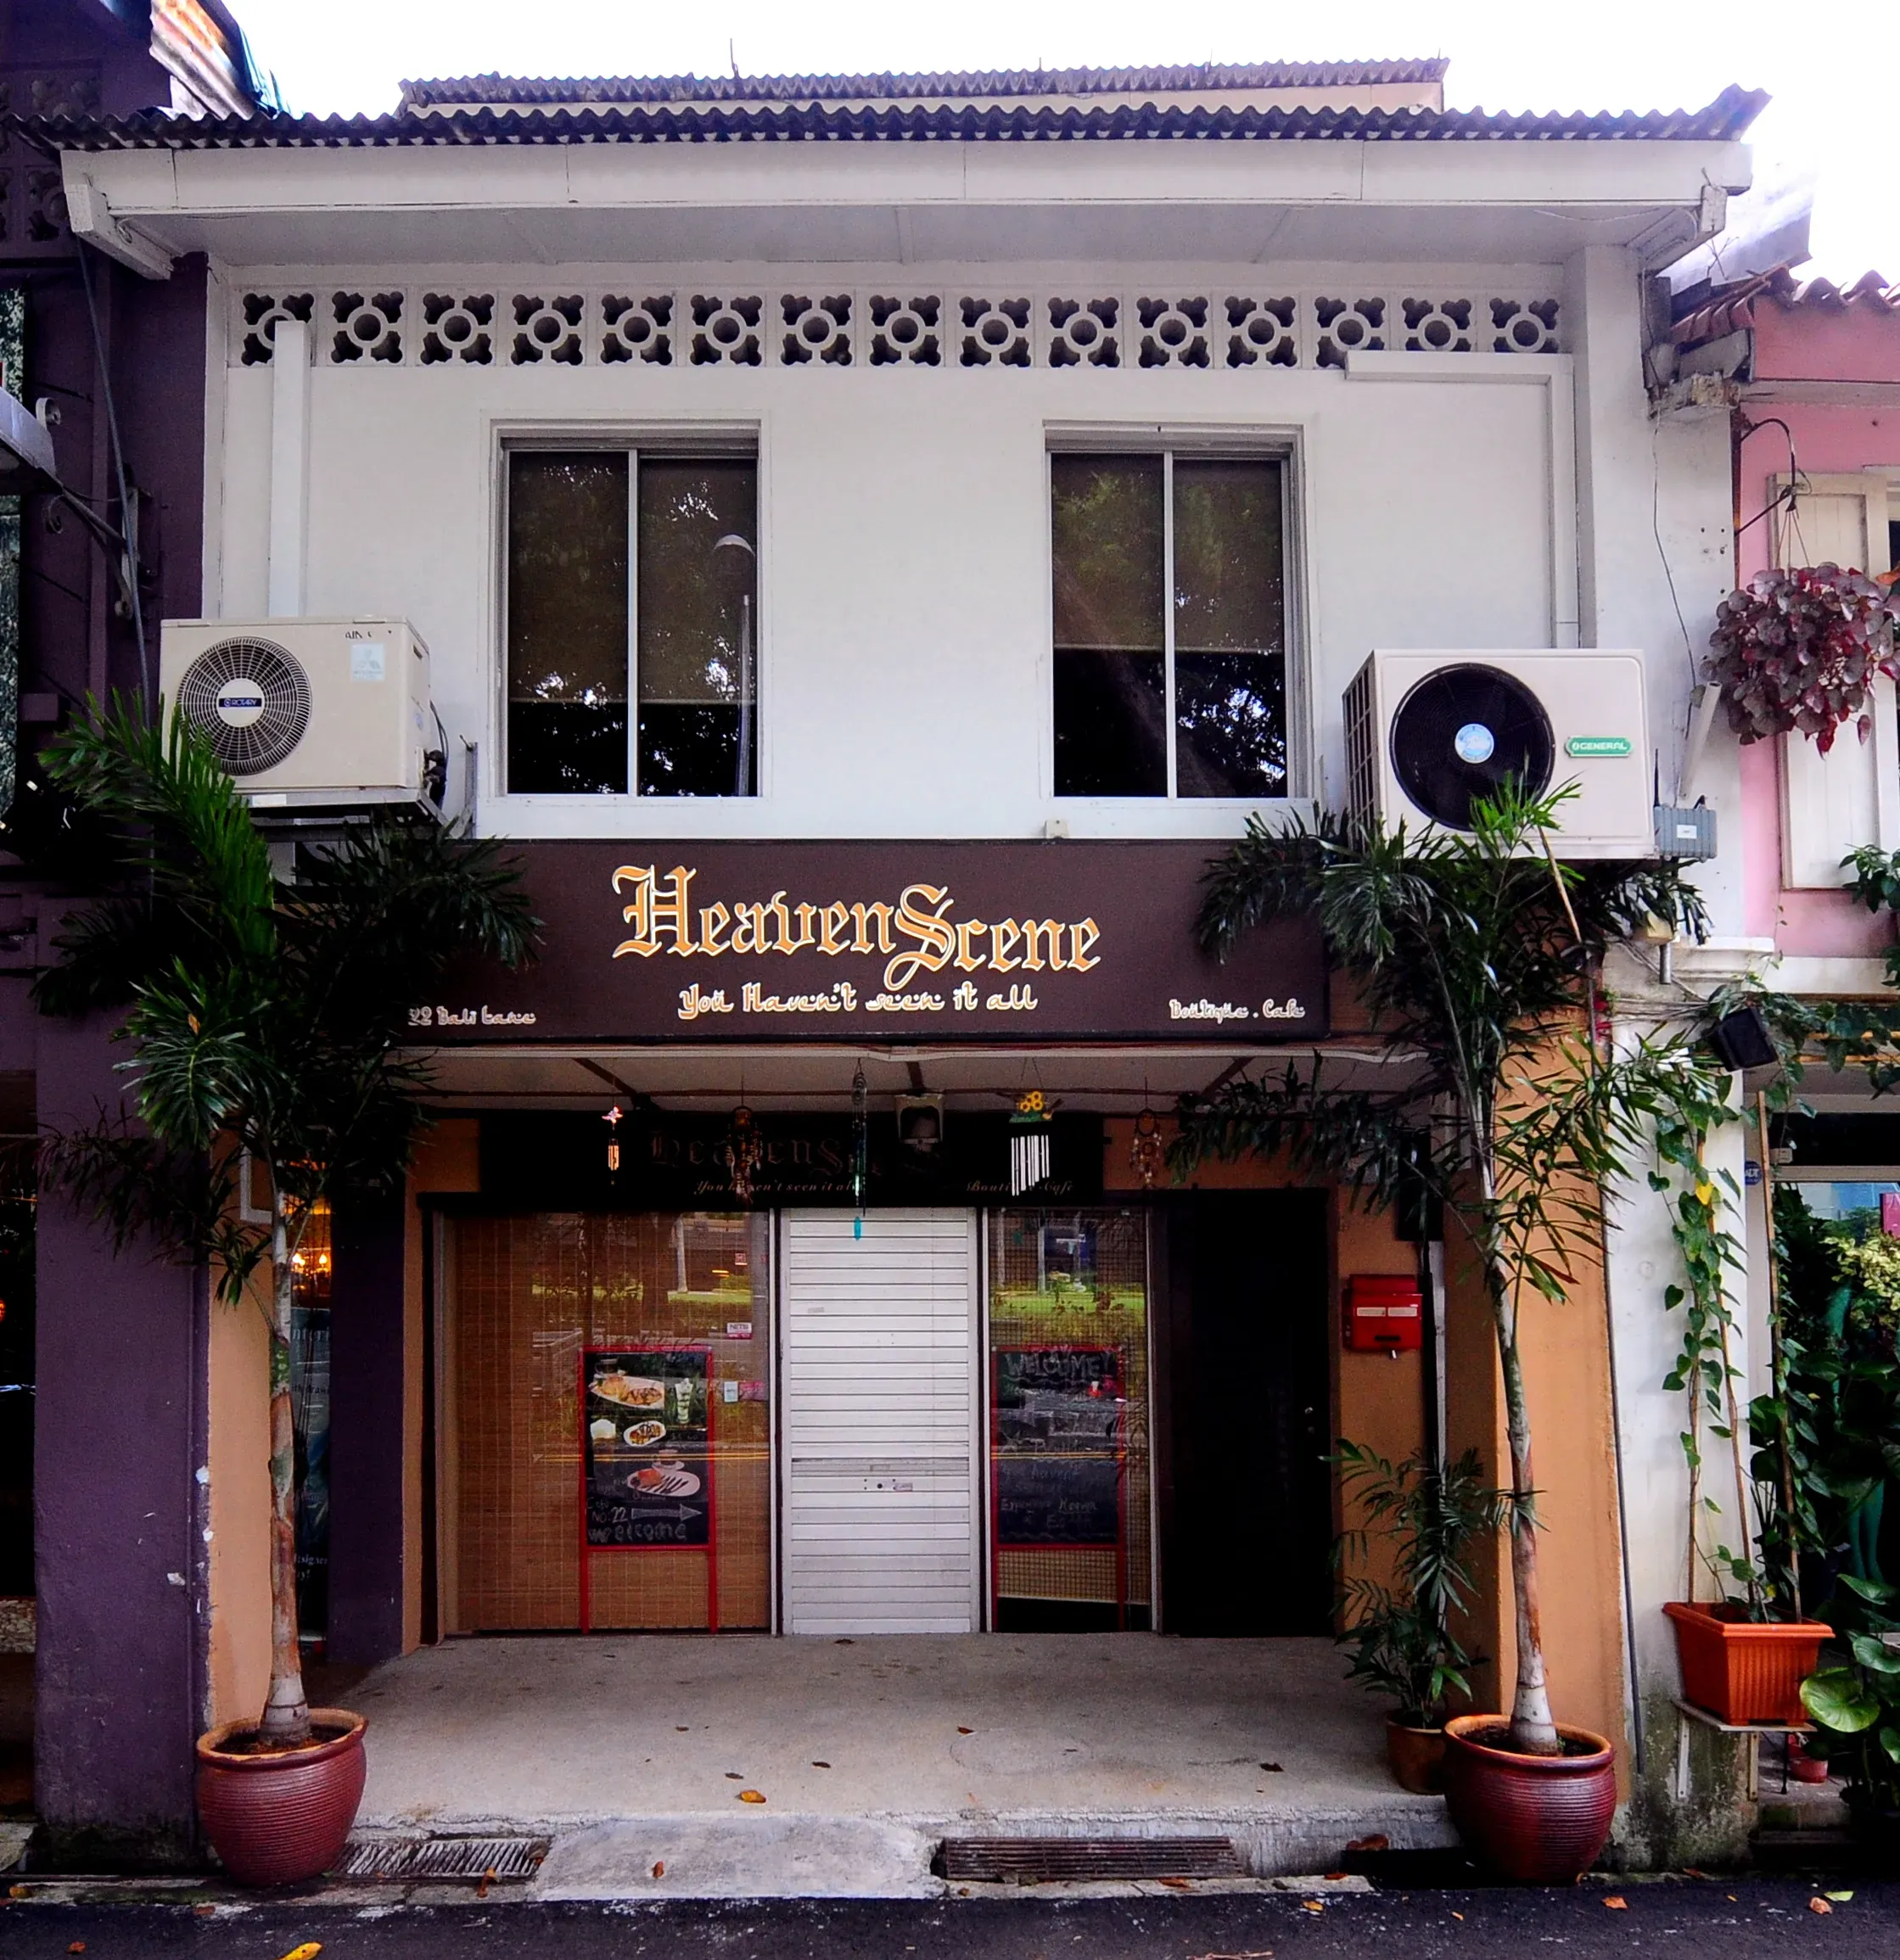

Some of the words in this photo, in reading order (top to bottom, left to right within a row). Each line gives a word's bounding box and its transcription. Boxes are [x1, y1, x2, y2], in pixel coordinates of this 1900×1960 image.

[612, 864, 1101, 991] HeavenScene
[678, 983, 735, 1020] You
[866, 990, 945, 1012] seen
[952, 980, 978, 1011] it
[985, 983, 1038, 1011] all
